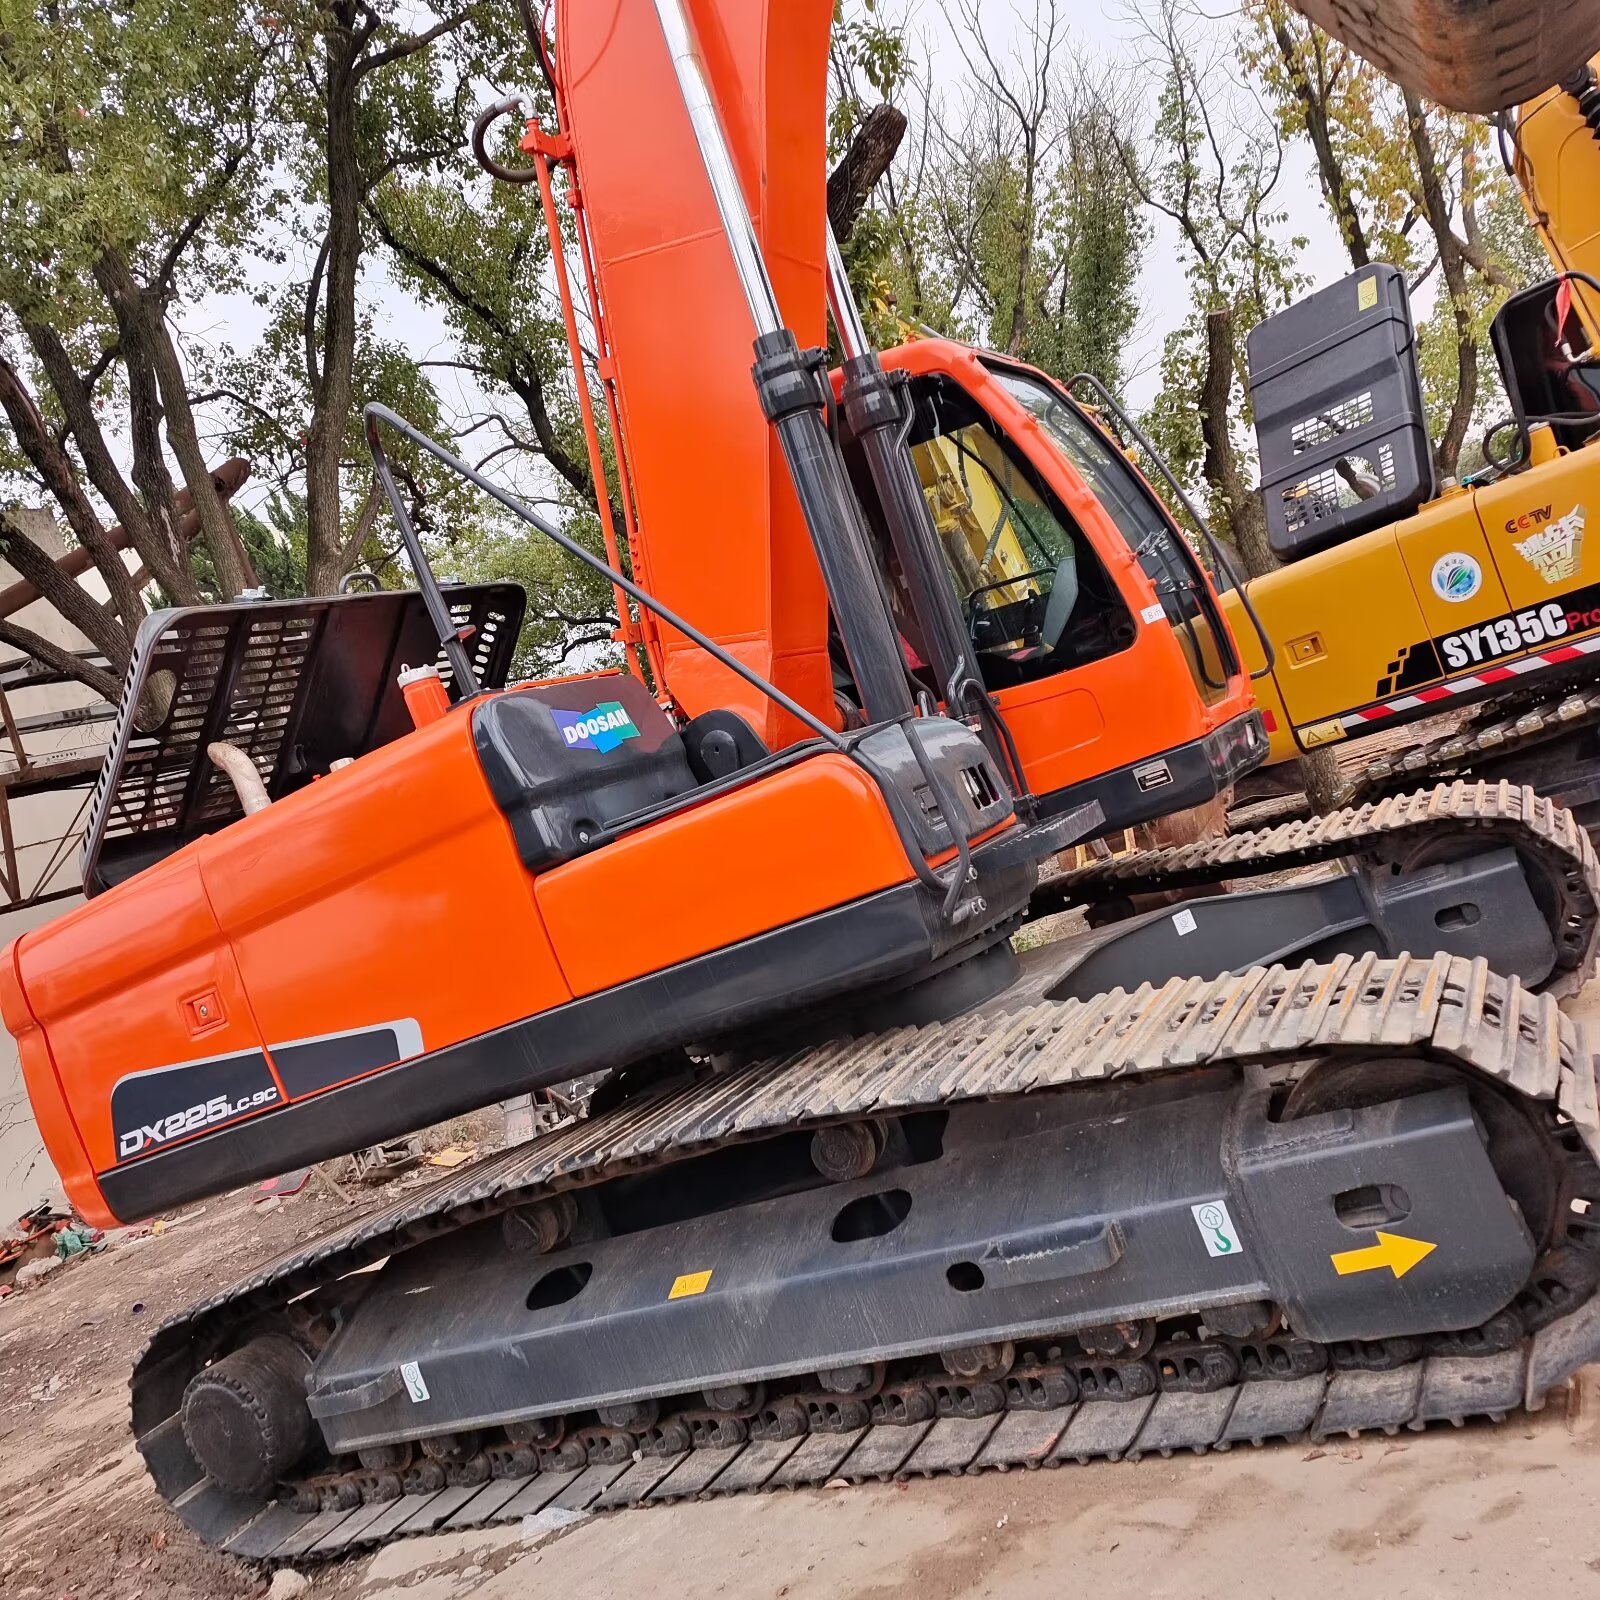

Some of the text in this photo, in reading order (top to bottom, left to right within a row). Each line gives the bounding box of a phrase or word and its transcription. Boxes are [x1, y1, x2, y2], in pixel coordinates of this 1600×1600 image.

[1505, 504, 1552, 533] CCTV
[1442, 603, 1568, 668] SY135C
[563, 709, 630, 744] DOOSAN
